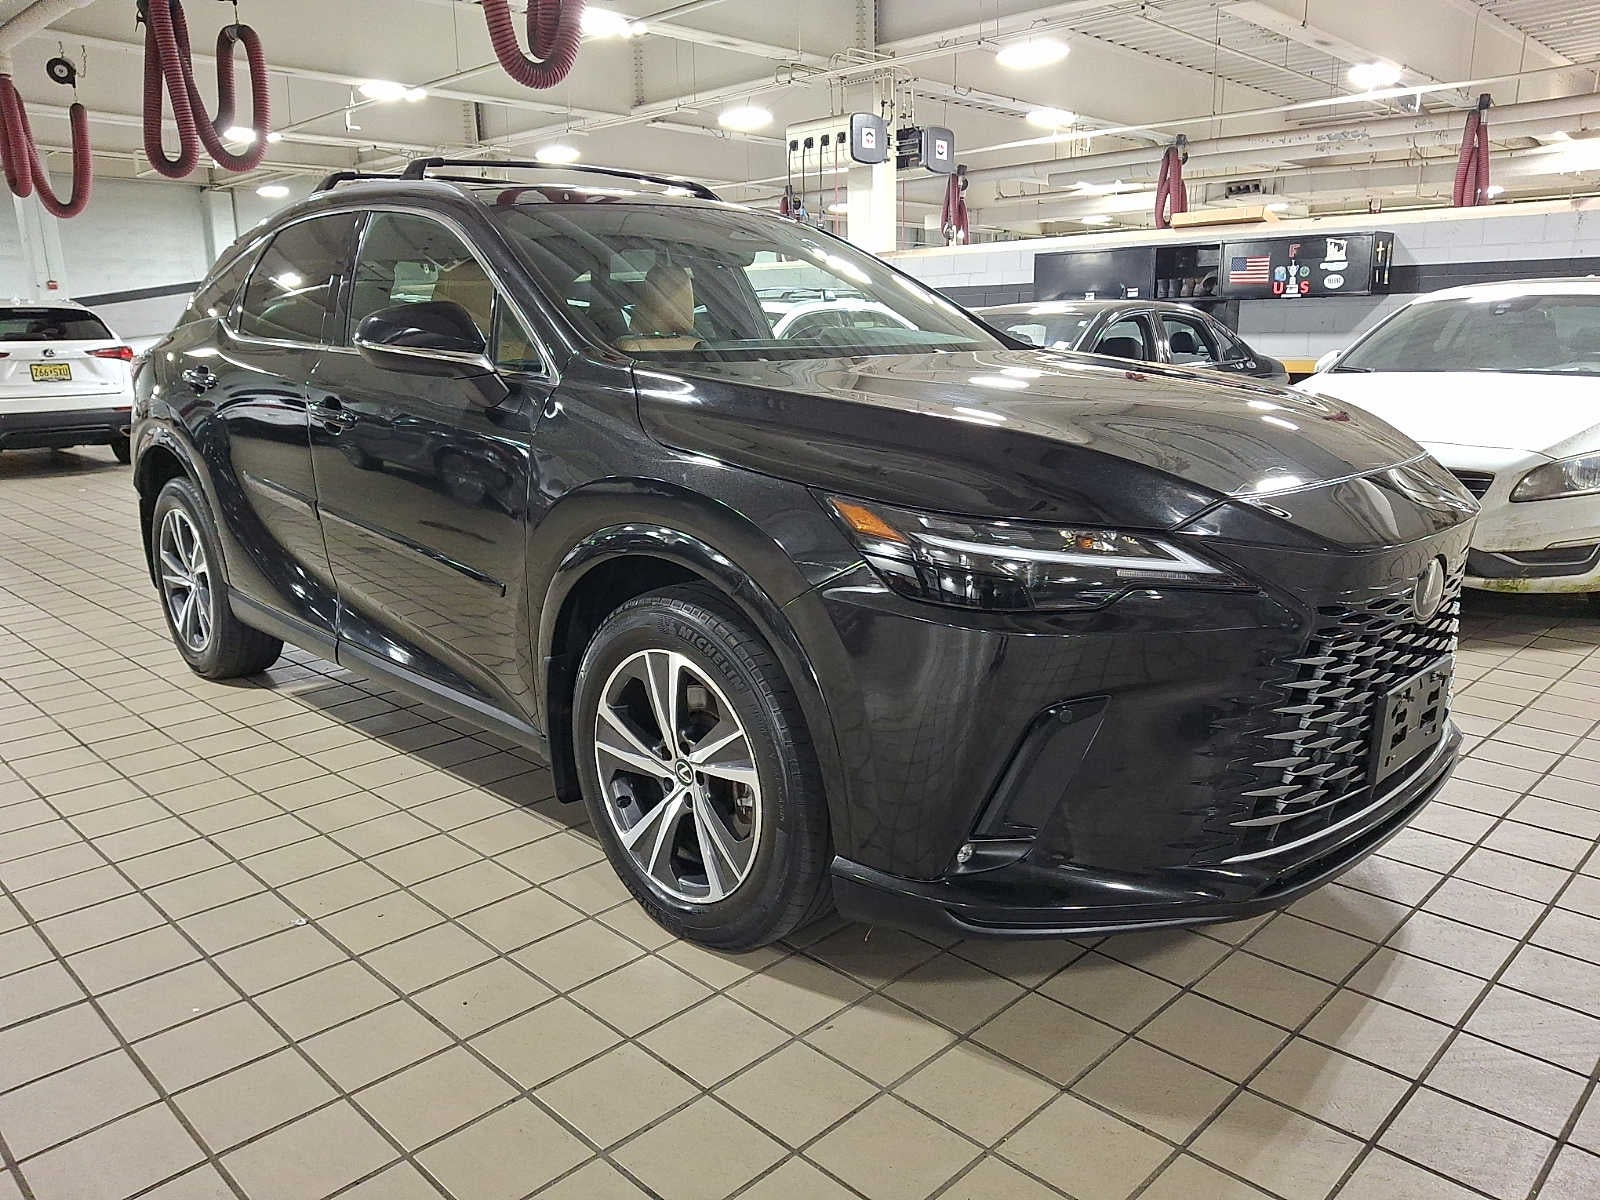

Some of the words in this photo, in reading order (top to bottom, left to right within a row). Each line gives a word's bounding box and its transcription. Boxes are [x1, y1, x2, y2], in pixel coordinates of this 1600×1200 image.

[1273, 281, 1284, 294] U
[1300, 280, 1310, 294] S
[678, 624, 751, 696] MICHELIN
